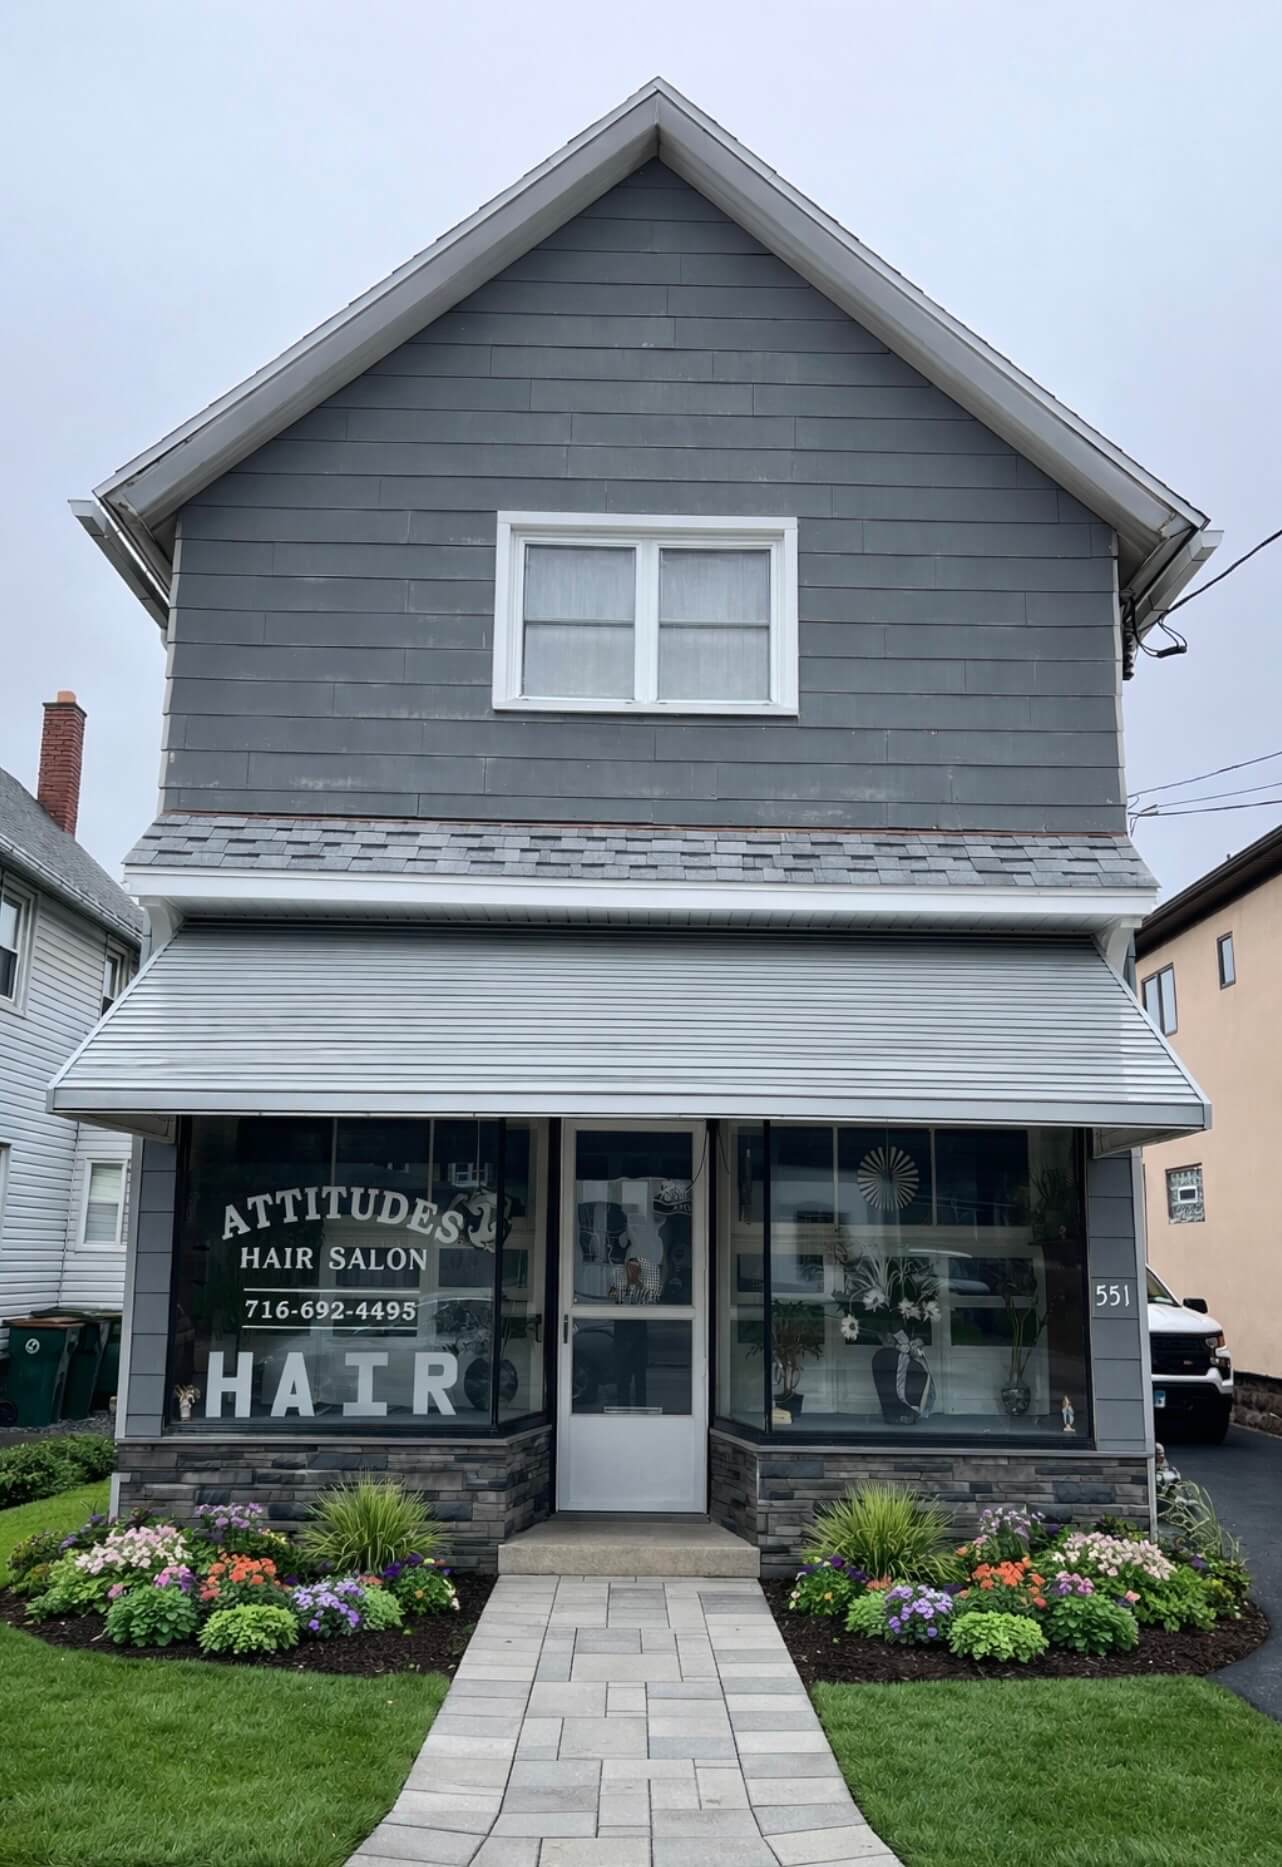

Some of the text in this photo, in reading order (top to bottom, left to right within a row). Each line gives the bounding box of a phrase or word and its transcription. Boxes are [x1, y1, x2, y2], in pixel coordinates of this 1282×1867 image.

[222, 1186, 464, 1244] ATTITUDES
[240, 1247, 428, 1271] HAIR SALON
[1096, 1284, 1130, 1307] 551
[245, 1300, 417, 1321] 716-692-4495
[205, 1351, 458, 1418] HAIR
